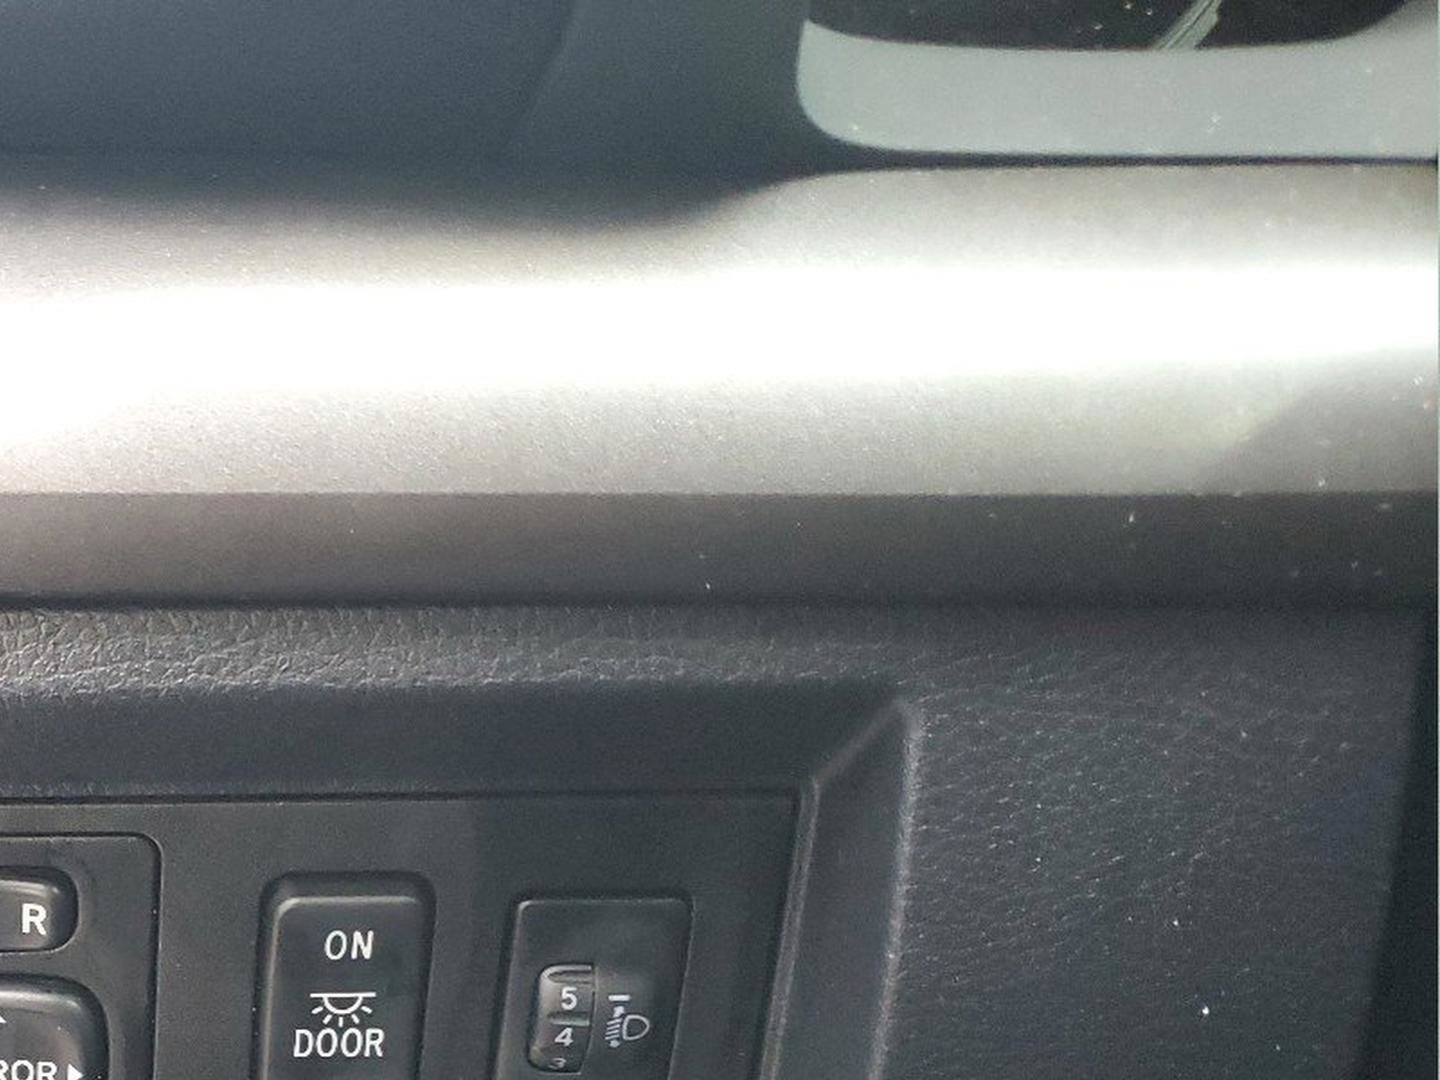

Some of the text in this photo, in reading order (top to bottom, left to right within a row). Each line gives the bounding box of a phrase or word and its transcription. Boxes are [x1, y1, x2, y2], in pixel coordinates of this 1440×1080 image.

[21, 903, 48, 936] R
[324, 929, 375, 960] ON
[561, 986, 578, 1011] 5
[293, 1028, 385, 1058] DOOR
[554, 1027, 574, 1047] 4
